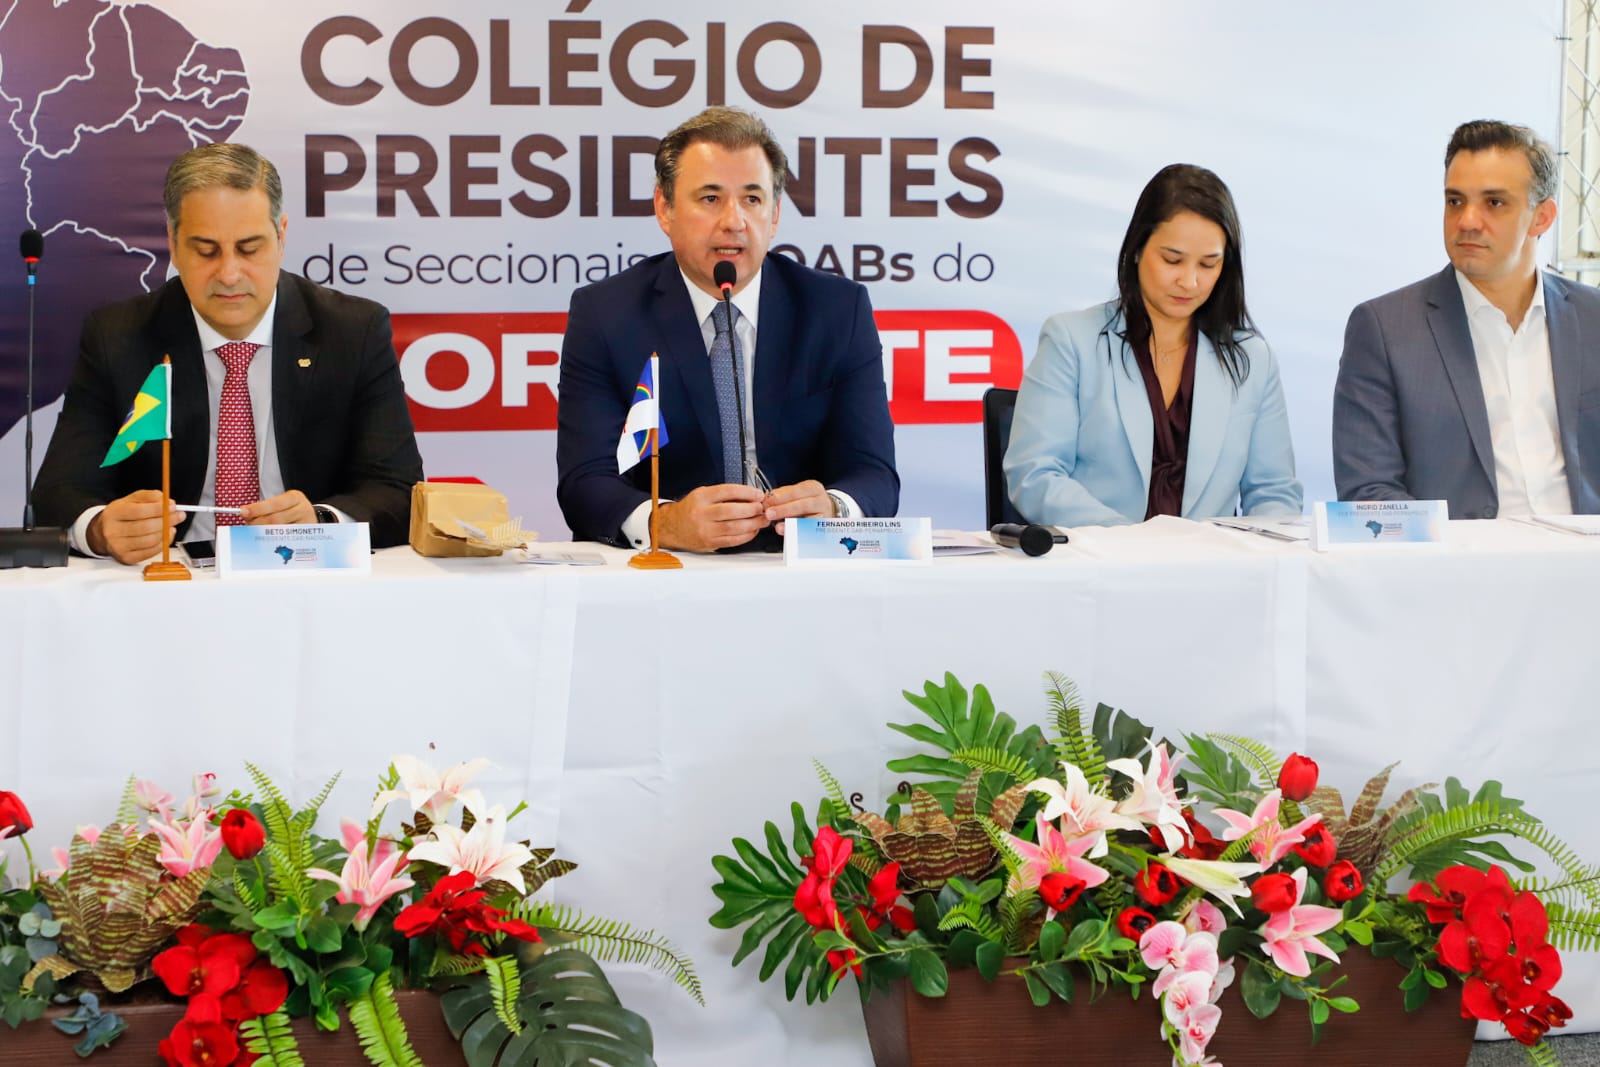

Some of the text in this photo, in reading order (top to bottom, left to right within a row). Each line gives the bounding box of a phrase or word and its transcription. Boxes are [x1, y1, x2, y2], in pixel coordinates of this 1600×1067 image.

[300, 0, 995, 110] COLÉGIO DE
[304, 133, 1005, 219] PRESIDNTES
[302, 243, 369, 285] de
[932, 242, 995, 283] do
